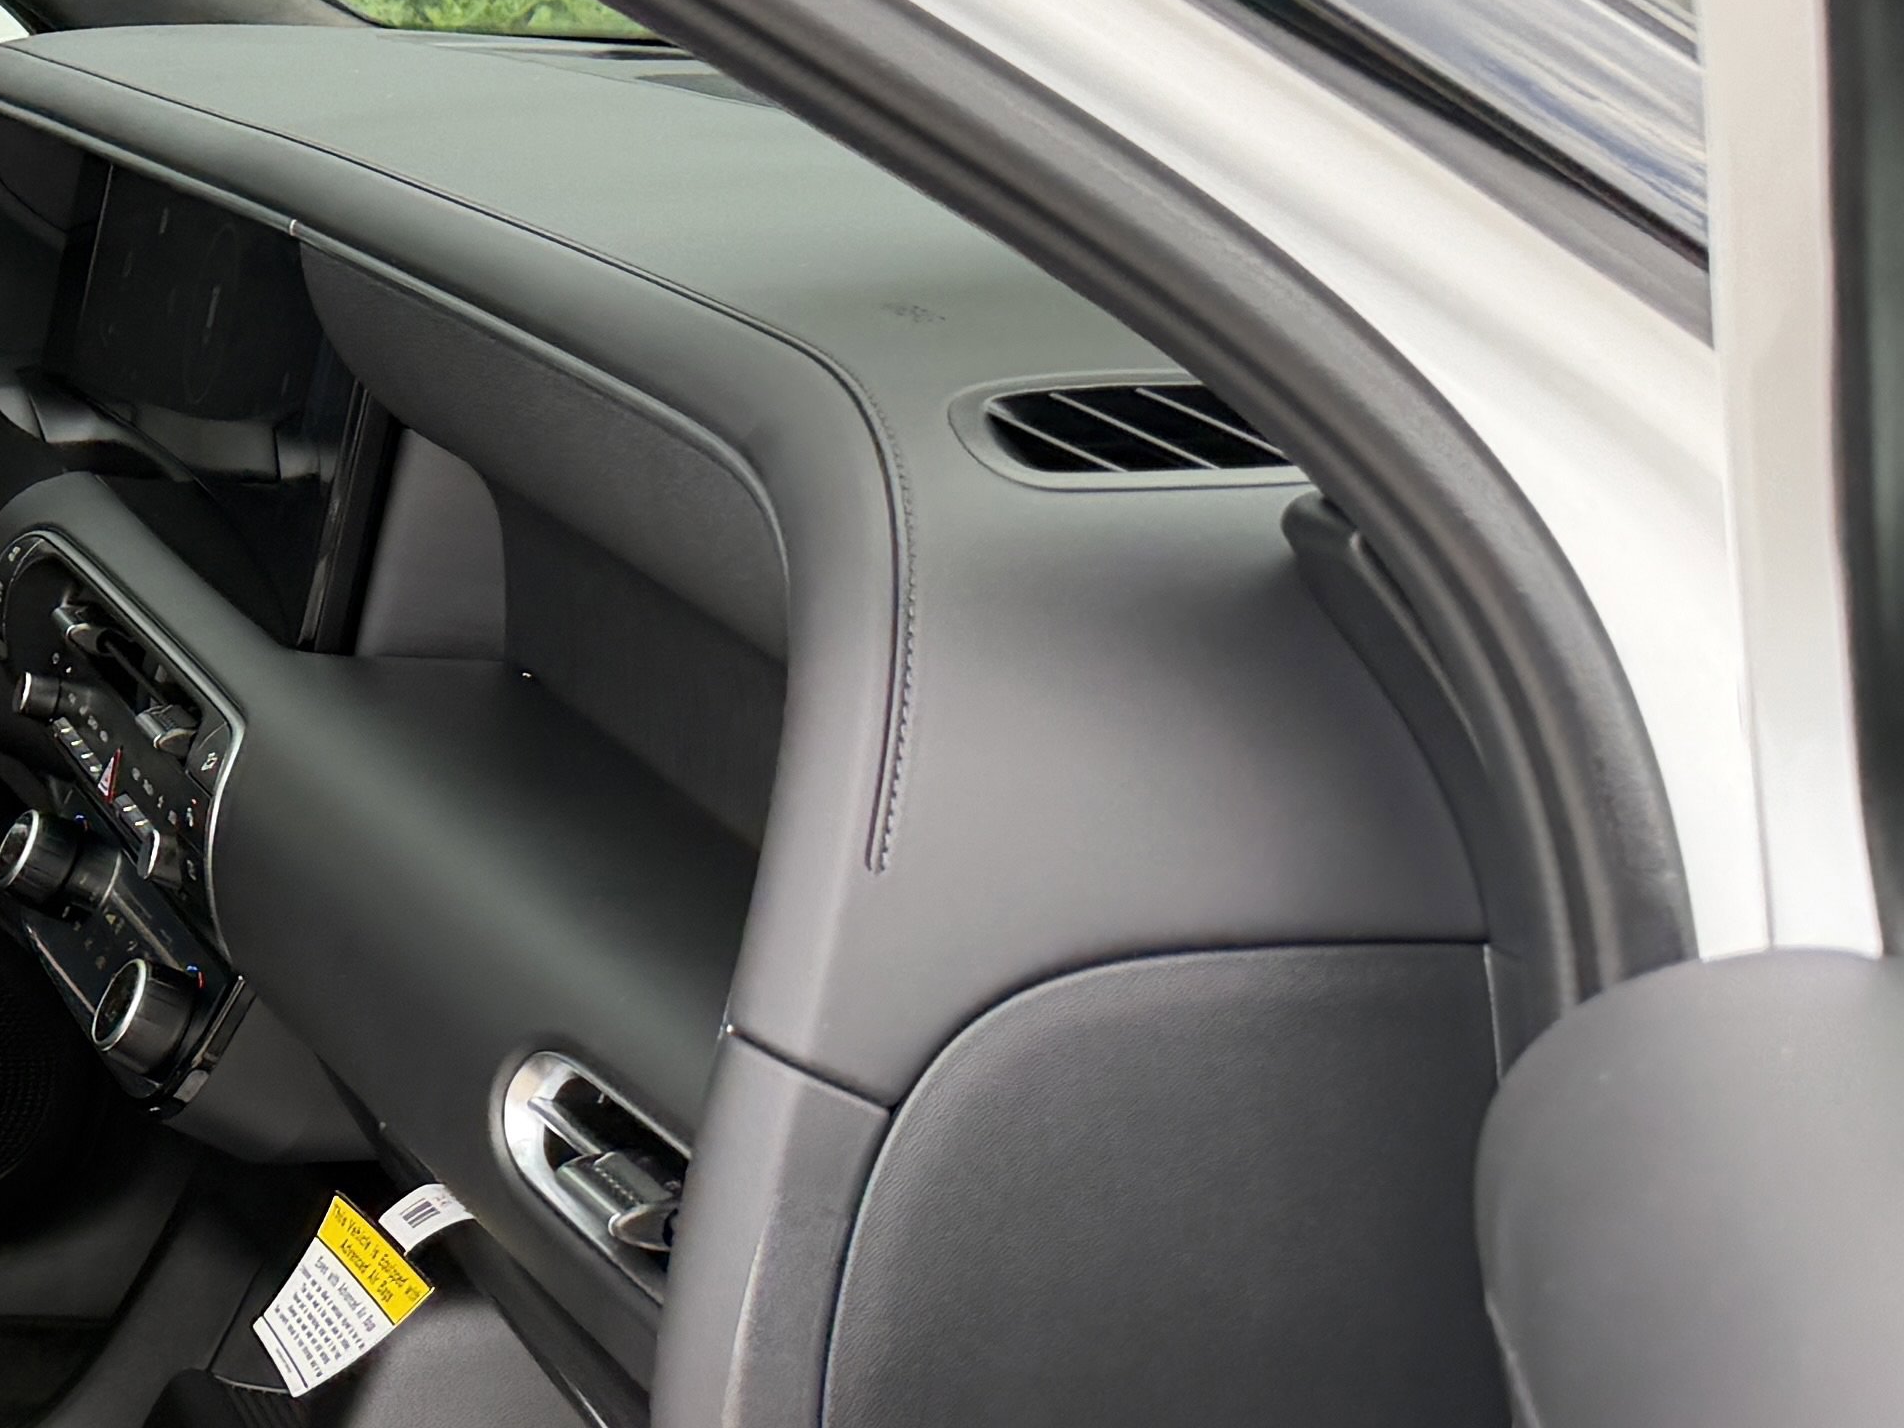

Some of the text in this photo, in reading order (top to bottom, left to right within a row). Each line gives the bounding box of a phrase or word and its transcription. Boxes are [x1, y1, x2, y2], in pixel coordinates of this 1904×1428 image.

[333, 1203, 347, 1227] This
[347, 1219, 371, 1250] Vehicle
[378, 1253, 408, 1288] Equipped
[340, 1238, 394, 1303] Advanced Air Bags
